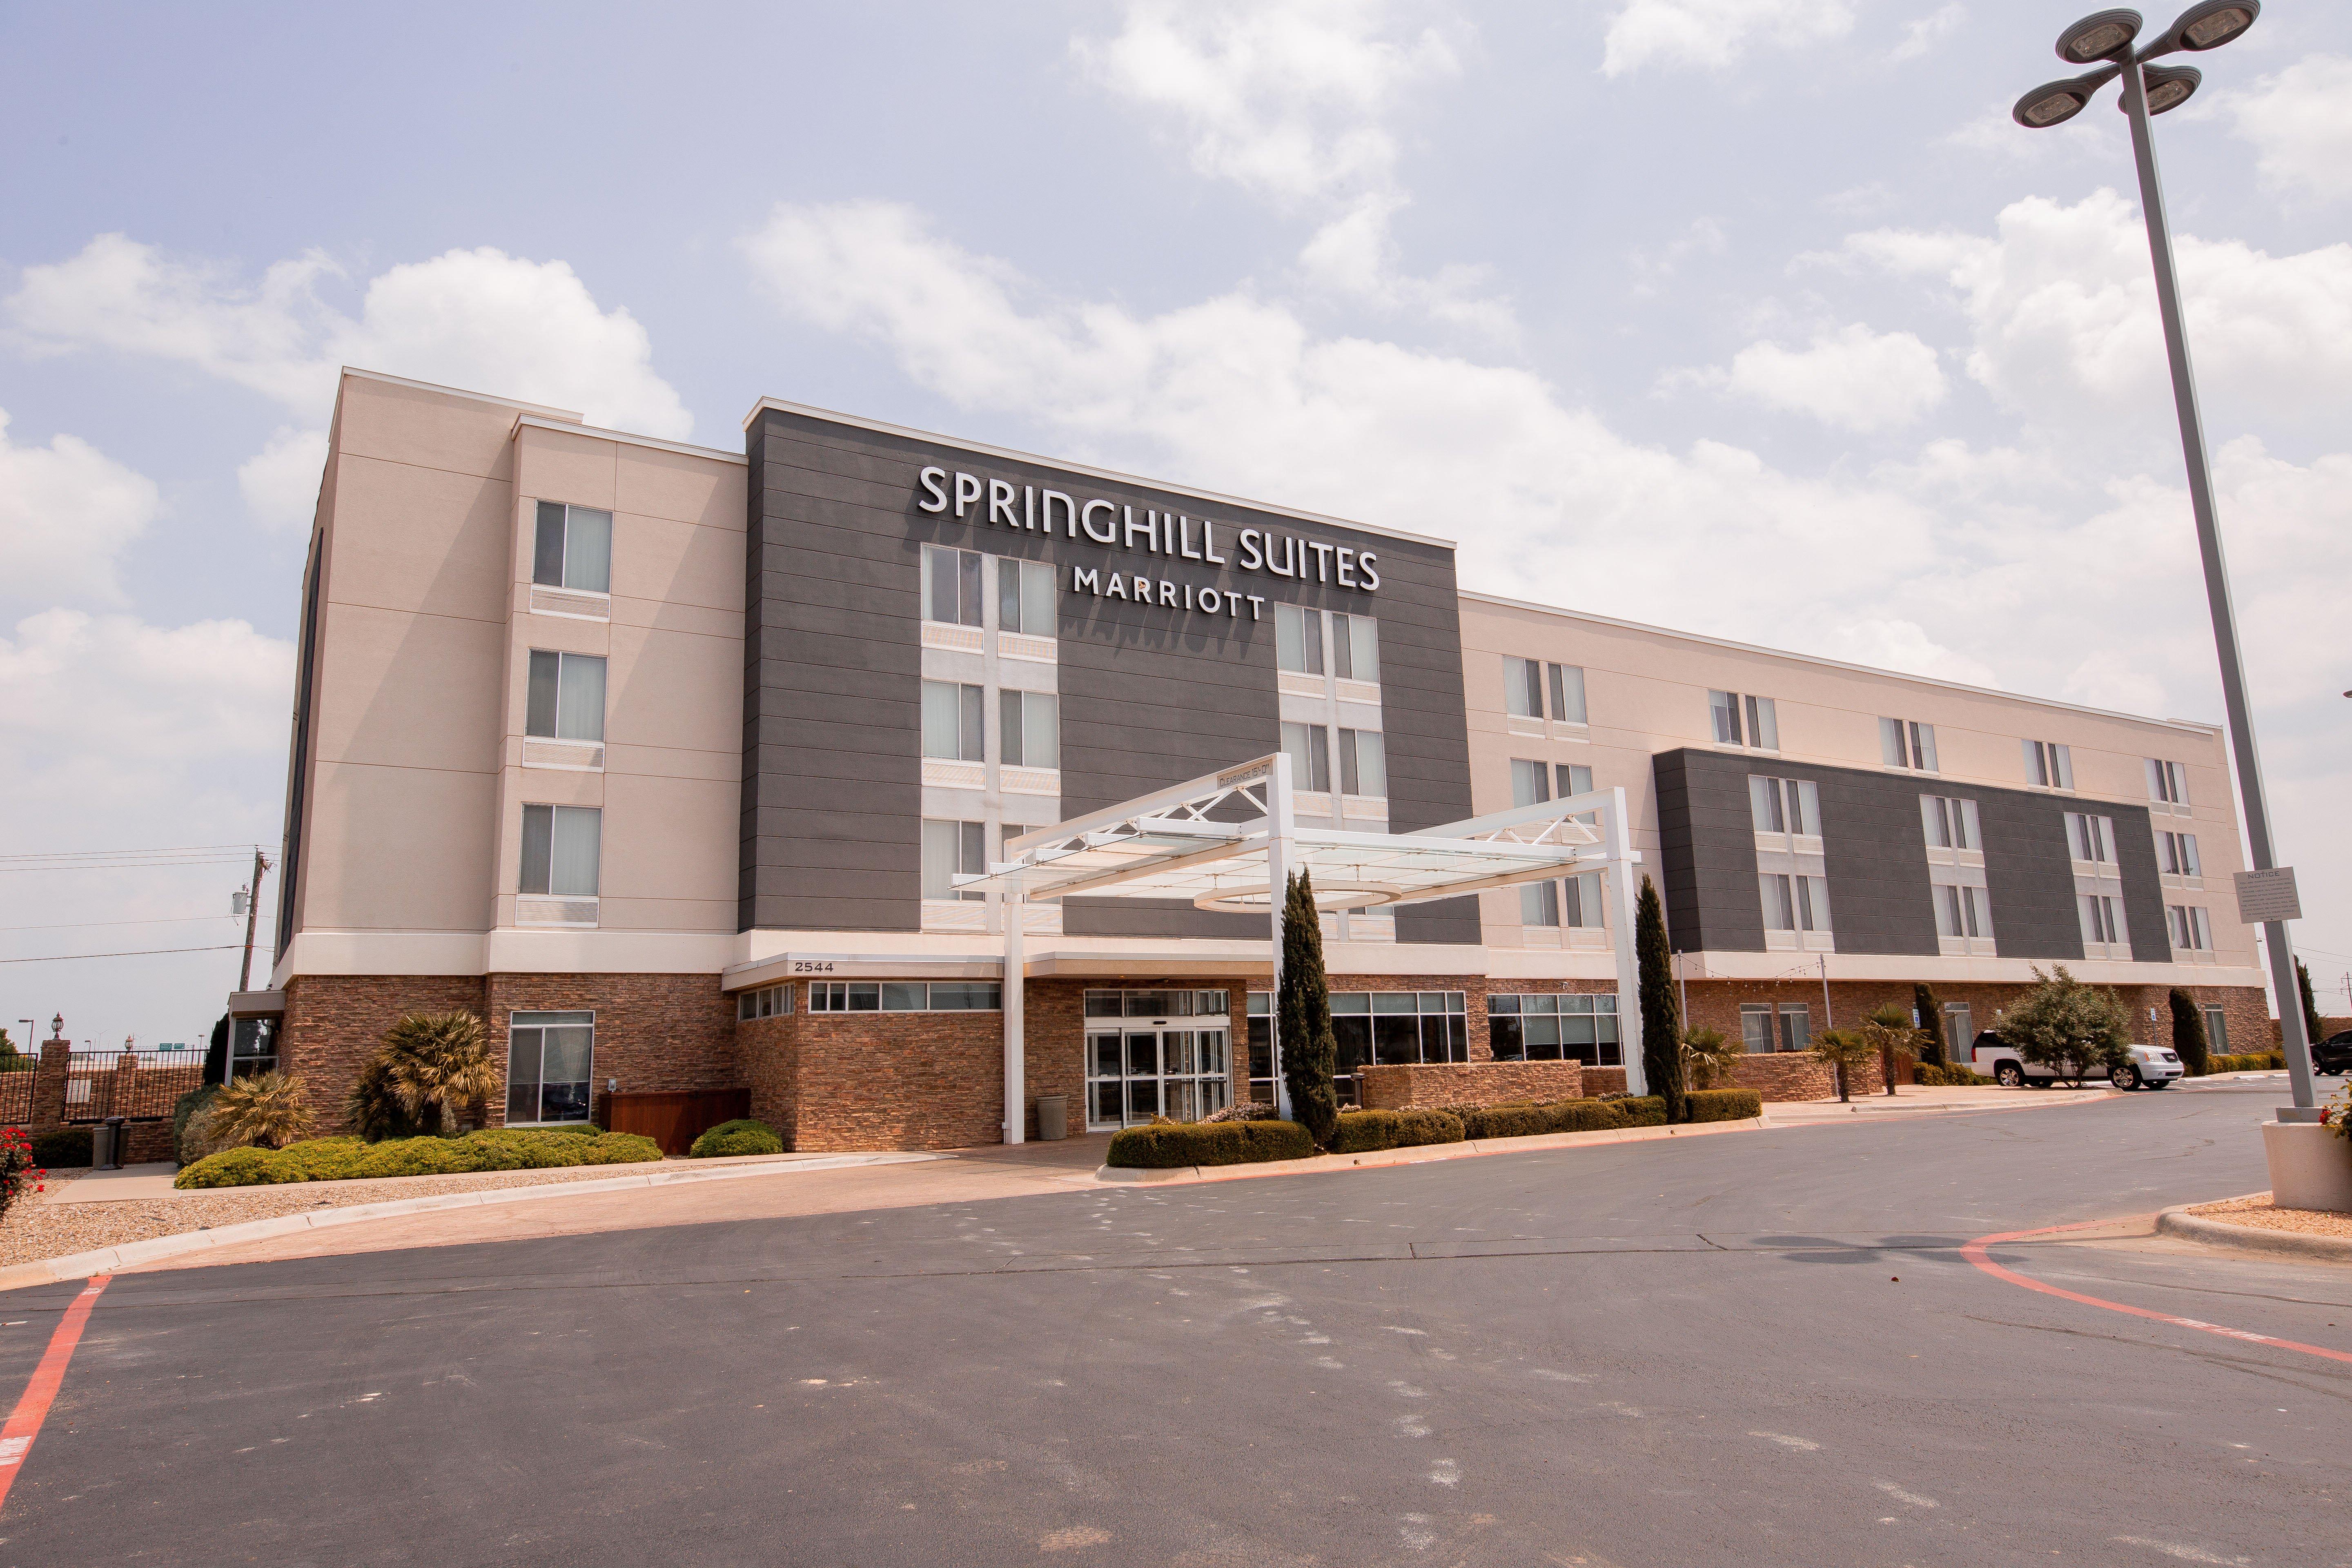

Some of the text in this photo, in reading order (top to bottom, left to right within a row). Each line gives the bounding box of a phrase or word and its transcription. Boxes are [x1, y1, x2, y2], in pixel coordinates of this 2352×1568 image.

[918, 466, 1380, 591] SPRINGHILL SUITES
[1074, 566, 1265, 621] MARRIOTT
[1219, 771, 1251, 787] CLEARANCE
[795, 962, 834, 972] 2544
[2164, 1318, 2278, 1341] FIRE LANE
